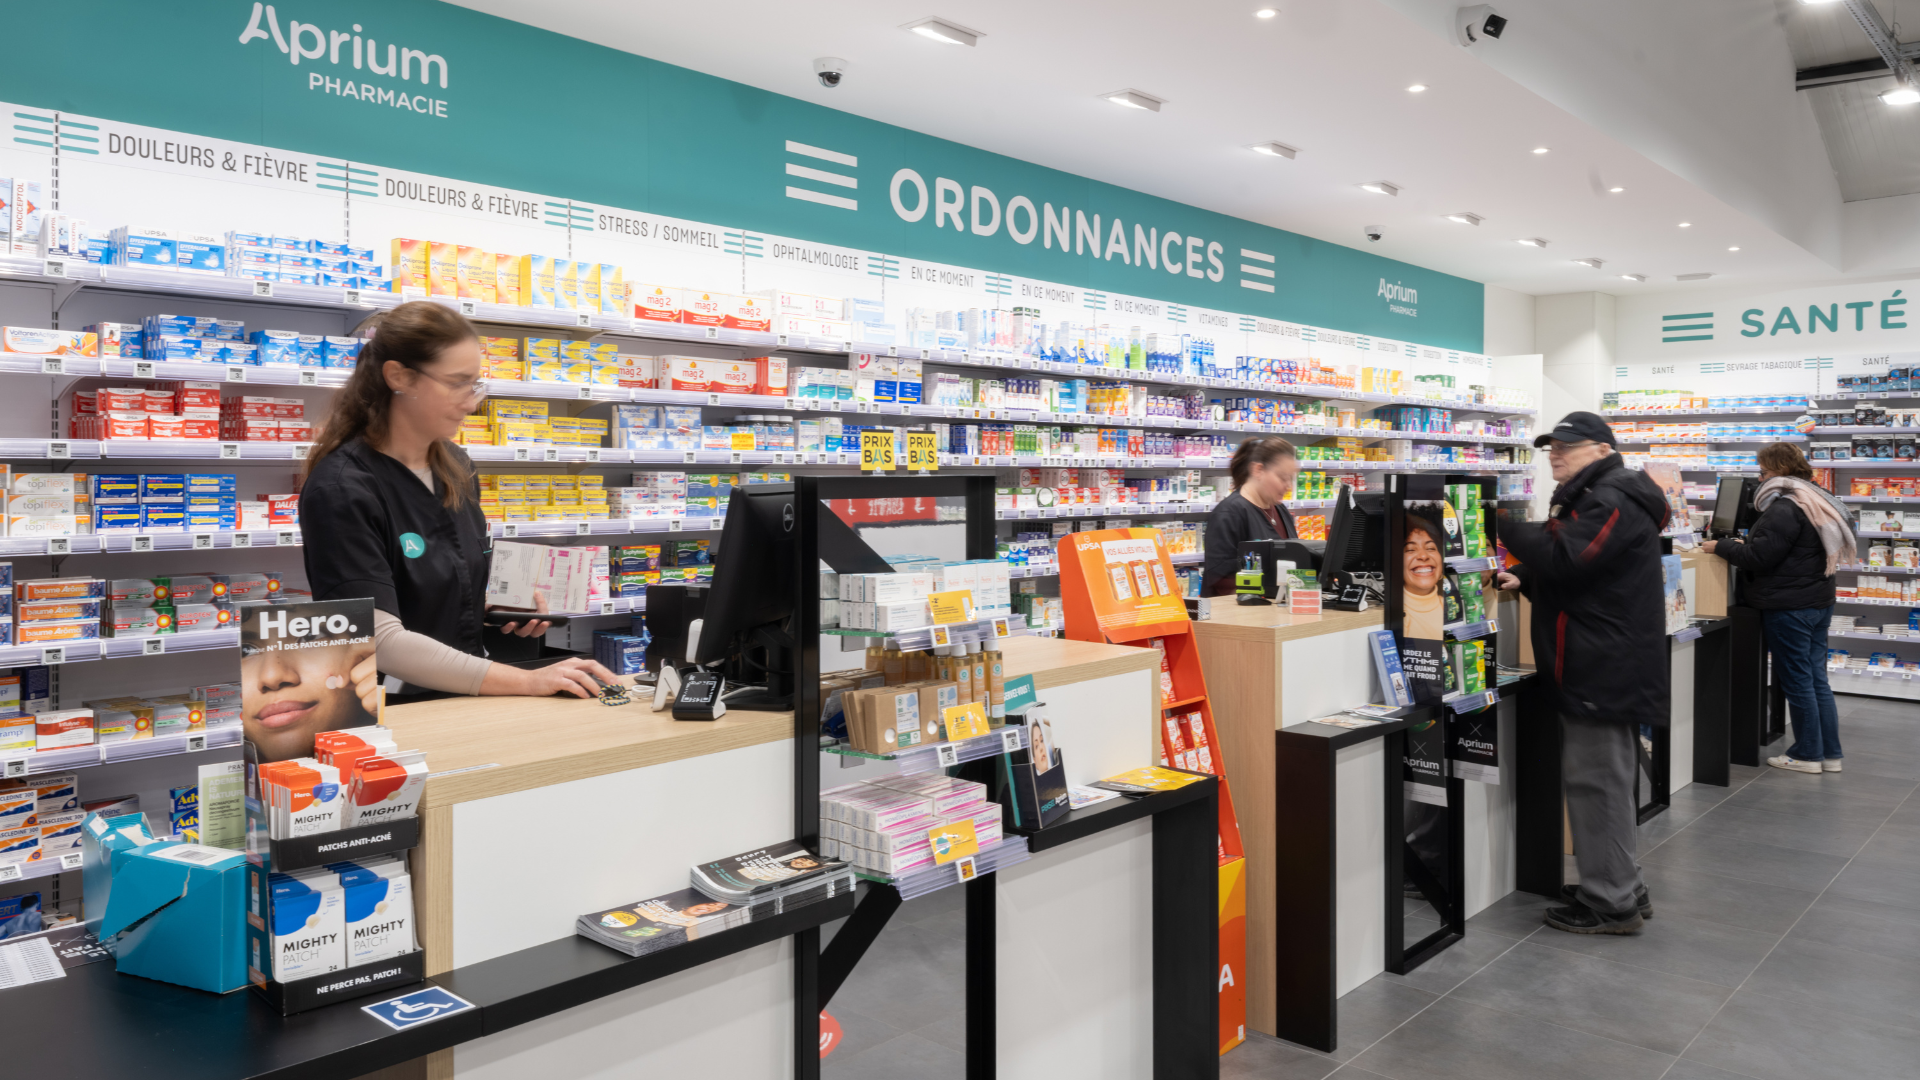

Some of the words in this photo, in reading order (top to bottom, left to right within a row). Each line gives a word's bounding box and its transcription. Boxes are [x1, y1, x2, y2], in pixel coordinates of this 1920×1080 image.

[239, 1, 449, 89] Aprium
[308, 72, 449, 119] PHARMACIE
[108, 132, 216, 172] DOULEURS
[221, 152, 237, 172] &
[243, 153, 309, 183] FIÈVRE
[385, 178, 467, 208] DOULEURS
[472, 193, 485, 211] &
[488, 193, 539, 220] FIÈVRE
[16, 182, 25, 232] NOCICEPTOL
[598, 213, 649, 238] STRESS
[653, 224, 659, 238] /
[663, 225, 719, 249] SOMMEIL
[889, 168, 1225, 283] ORDONNANCES
[143, 229, 167, 238] UPSA
[193, 235, 215, 243] UPSA
[773, 244, 859, 270] OPHTALMOLOGIE
[911, 266, 923, 280] EN
[925, 269, 937, 282] CE
[939, 271, 974, 288] MOMENT
[1021, 284, 1032, 296] EN
[1033, 286, 1043, 298] CE
[1045, 288, 1075, 304] MOMENT
[1377, 278, 1417, 304] Aprium
[647, 295, 662, 306] mag
[663, 296, 671, 306] 2
[694, 301, 709, 312] mag
[710, 302, 718, 311] 2
[739, 307, 752, 317] mag
[753, 307, 761, 316] 2
[1114, 299, 1123, 311] EN
[1125, 301, 1133, 313] CE
[1134, 303, 1160, 316] MOMENT
[1389, 304, 1417, 317] PHARMACIE
[1740, 289, 1907, 338] SANTÉ
[1198, 313, 1228, 327] VITAMINES
[1256, 321, 1279, 335] DOULEURS
[770, 361, 781, 369] mag
[1726, 362, 1758, 371] SEVRAGE
[1760, 360, 1802, 371] TABAGIQUE
[1862, 355, 1890, 366] SANTÉ
[619, 367, 633, 378] mag
[635, 367, 642, 375] 2
[682, 370, 697, 379] mag
[698, 370, 704, 378] 2
[1652, 365, 1675, 375] SANTÉ
[725, 373, 739, 383] mag
[740, 373, 747, 381] 2
[863, 435, 891, 448] PRIX
[909, 436, 934, 448] PRIX
[863, 449, 892, 465] BAS
[910, 449, 935, 465] BAS
[1077, 542, 1101, 551] UPSA
[1105, 547, 1117, 556] VOS
[1117, 545, 1135, 554] ALLIÉS
[33, 586, 60, 594] baume
[61, 584, 88, 593] Arôma
[26, 607, 53, 615] baume
[55, 605, 82, 614] Arôma
[259, 610, 358, 639] Hero.
[25, 628, 52, 637] baume
[53, 626, 82, 635] Arôma
[266, 640, 283, 652] N°1
[300, 640, 328, 649] PATCHS
[1403, 657, 1439, 665] YTHME
[1417, 672, 1437, 680] FROID
[207, 690, 236, 698] NUROFEN
[207, 711, 235, 719] NUROFEN
[101, 720, 132, 728] NUROFEN
[1457, 737, 1494, 750] Aprium
[1467, 748, 1494, 756] PHARMACIE
[1403, 756, 1440, 770] Aprium
[1412, 767, 1440, 776] PHARMACIE
[30, 778, 63, 787] PIASCLEDINE
[178, 793, 199, 805] Adv
[360, 802, 412, 818] MIGHTY
[884, 808, 925, 823] HOMÉOPLASMINE
[38, 816, 73, 825] PIASCLEDINE
[176, 816, 199, 827] Adv
[294, 812, 334, 825] MIGHTY
[0, 829, 27, 838] SCLEDINE
[318, 841, 348, 853] PATCHS
[349, 832, 392, 847] ANTI-ACNÉ
[353, 918, 405, 939] MIGHTY
[283, 932, 338, 953] MIGHTY
[316, 986, 329, 994] NE
[329, 981, 354, 992] PERCE
[355, 975, 372, 986] PAS,
[373, 970, 397, 981] PATCH
